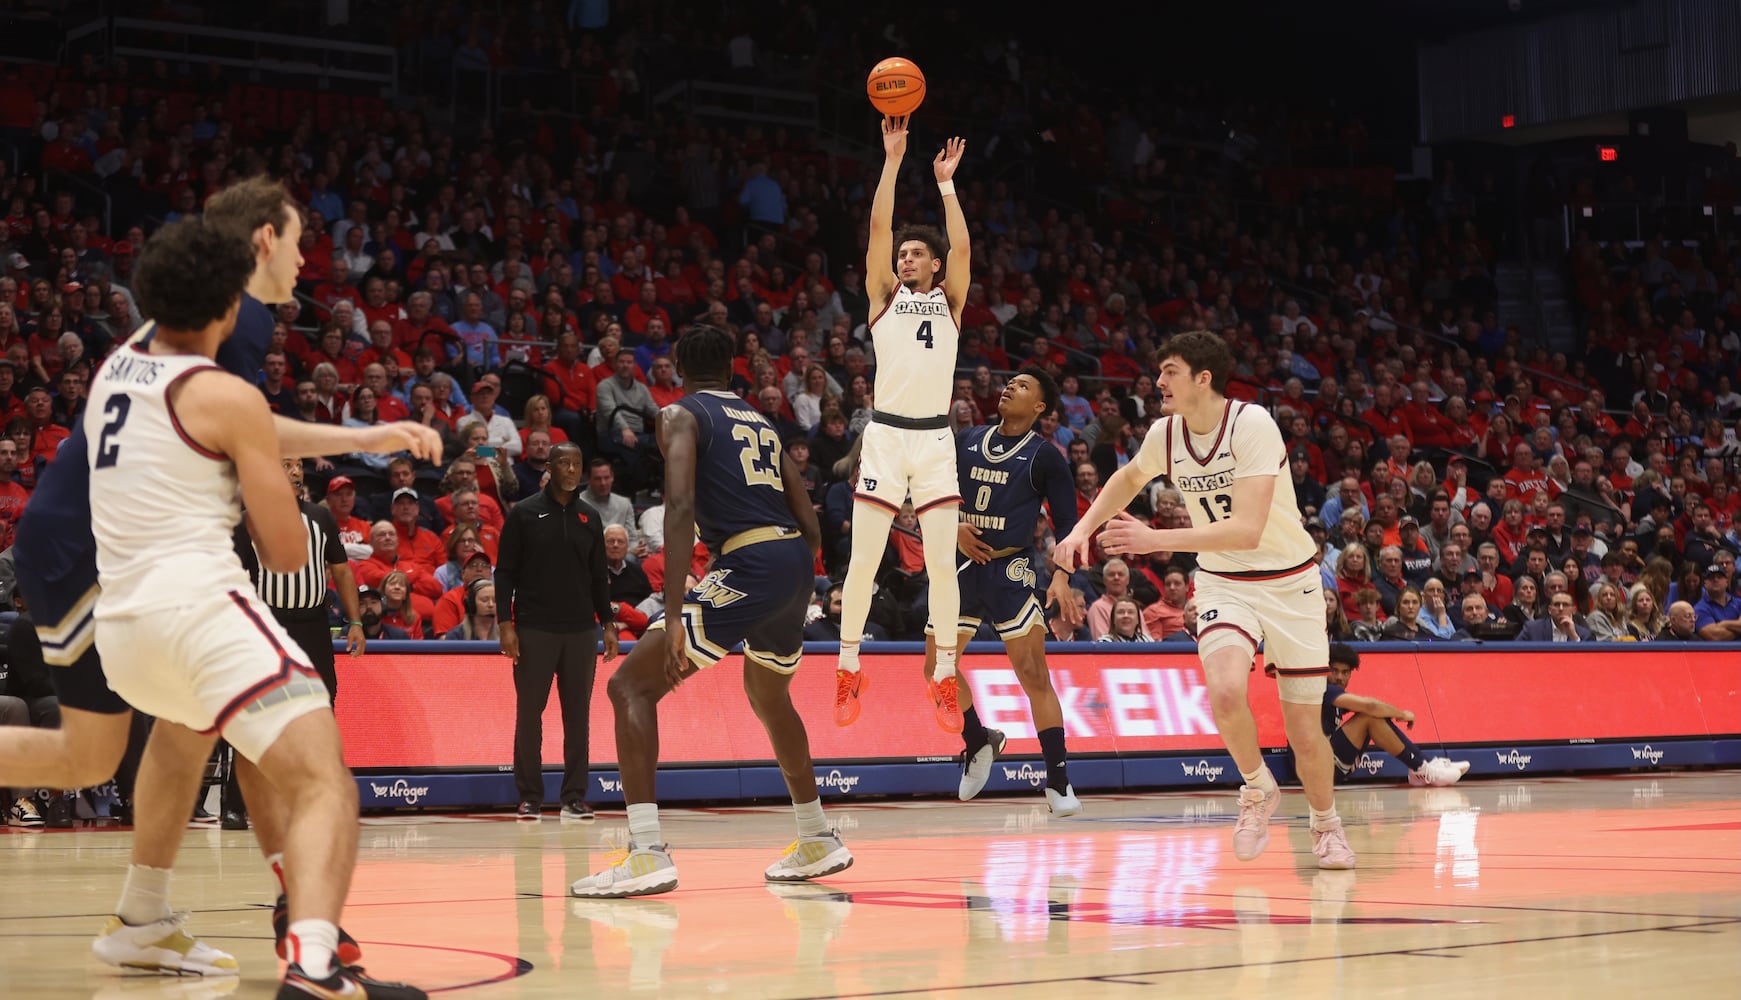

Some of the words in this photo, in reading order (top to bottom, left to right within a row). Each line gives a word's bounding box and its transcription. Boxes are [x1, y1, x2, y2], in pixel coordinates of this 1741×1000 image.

[895, 301, 947, 317] DAYTON
[916, 320, 934, 349] 4
[105, 355, 165, 386] SANTOS
[95, 393, 132, 470] 2
[731, 423, 784, 492] 23
[970, 466, 1009, 485] GEORGE
[975, 485, 992, 511] 0
[1508, 749, 1531, 770] Kroger
[1641, 744, 1664, 765] Kroger
[826, 769, 859, 793] Kroger
[1195, 760, 1224, 782] Kroger
[389, 779, 429, 805] Kroger
